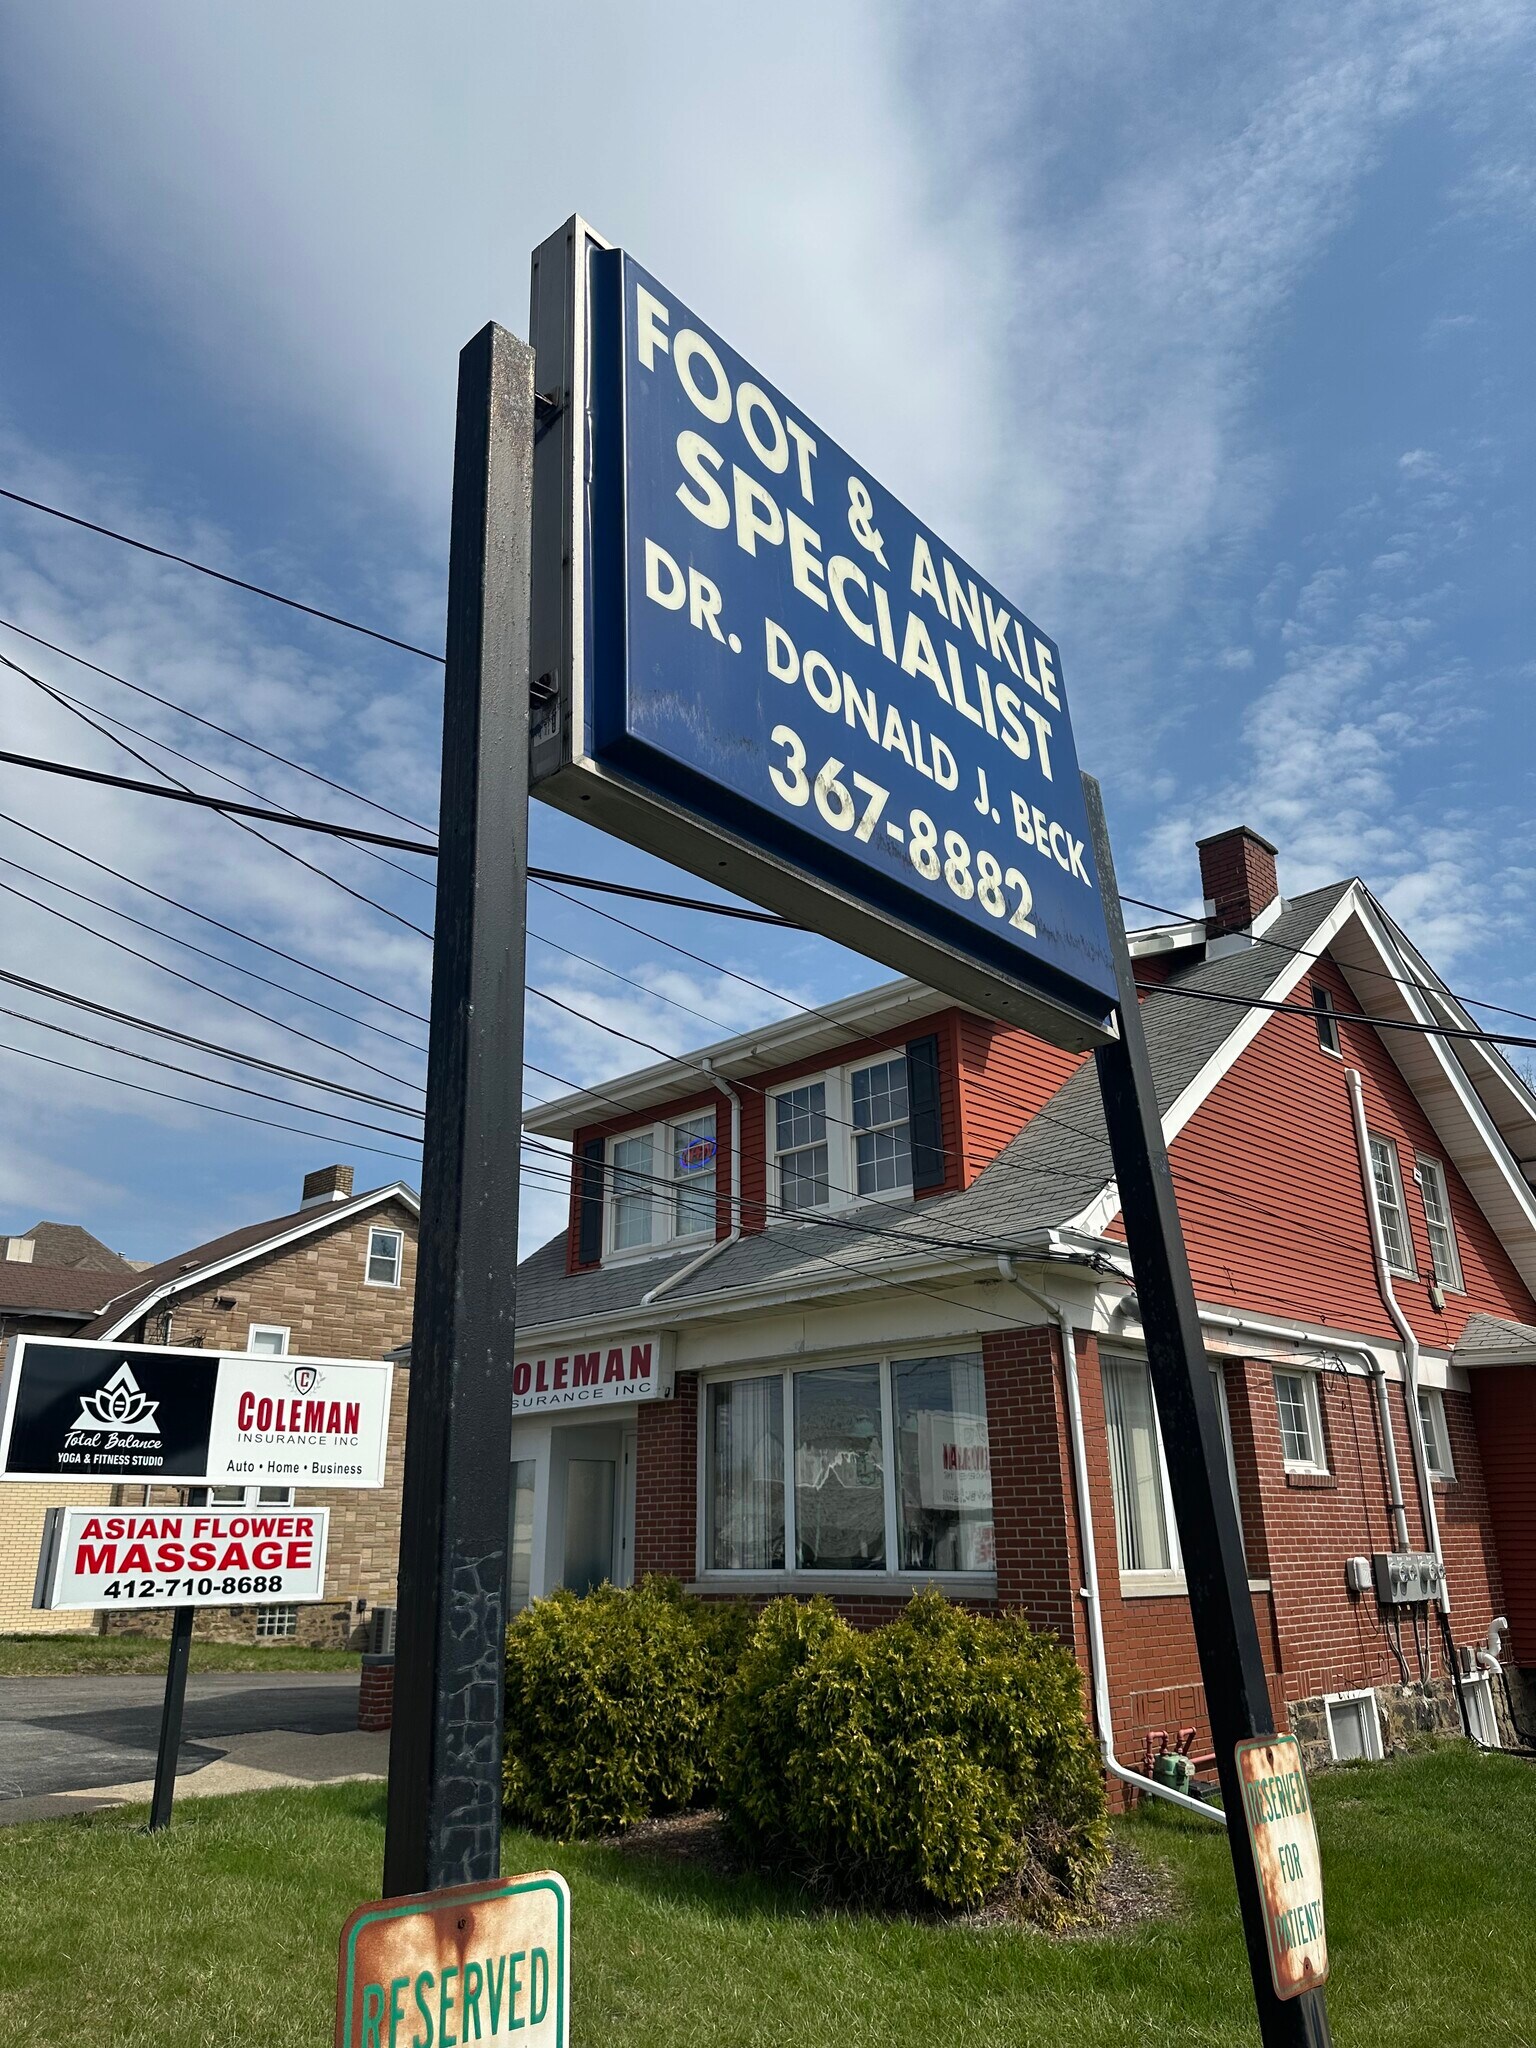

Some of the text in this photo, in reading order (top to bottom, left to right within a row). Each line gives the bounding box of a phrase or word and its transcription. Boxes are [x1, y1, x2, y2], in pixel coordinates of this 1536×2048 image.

[637, 283, 1062, 712] FOOT & ANKLE
[676, 430, 1054, 782] SPECIALIST
[644, 537, 1093, 888] DR. DONALD J. BECK
[768, 724, 1037, 938] 367-8882
[512, 1343, 652, 1396] OLEMAN
[237, 1391, 360, 1434] COLEMAN
[511, 1382, 651, 1409] SURANCE INC
[58, 1452, 164, 1466] YOGA & FITNESS STUDIO
[64, 1430, 163, 1450] Total Balance
[237, 1433, 359, 1447] INSURANCE INC
[226, 1459, 363, 1475] Auto Home Business
[80, 1517, 314, 1539] ASIAN FLOWER
[75, 1541, 313, 1574] MASSAGE
[103, 1575, 283, 1599] 412-710-8688
[1246, 1771, 1308, 1824] RESERVED
[1278, 1842, 1304, 1884] FOR
[361, 1946, 549, 2048] RESERVED
